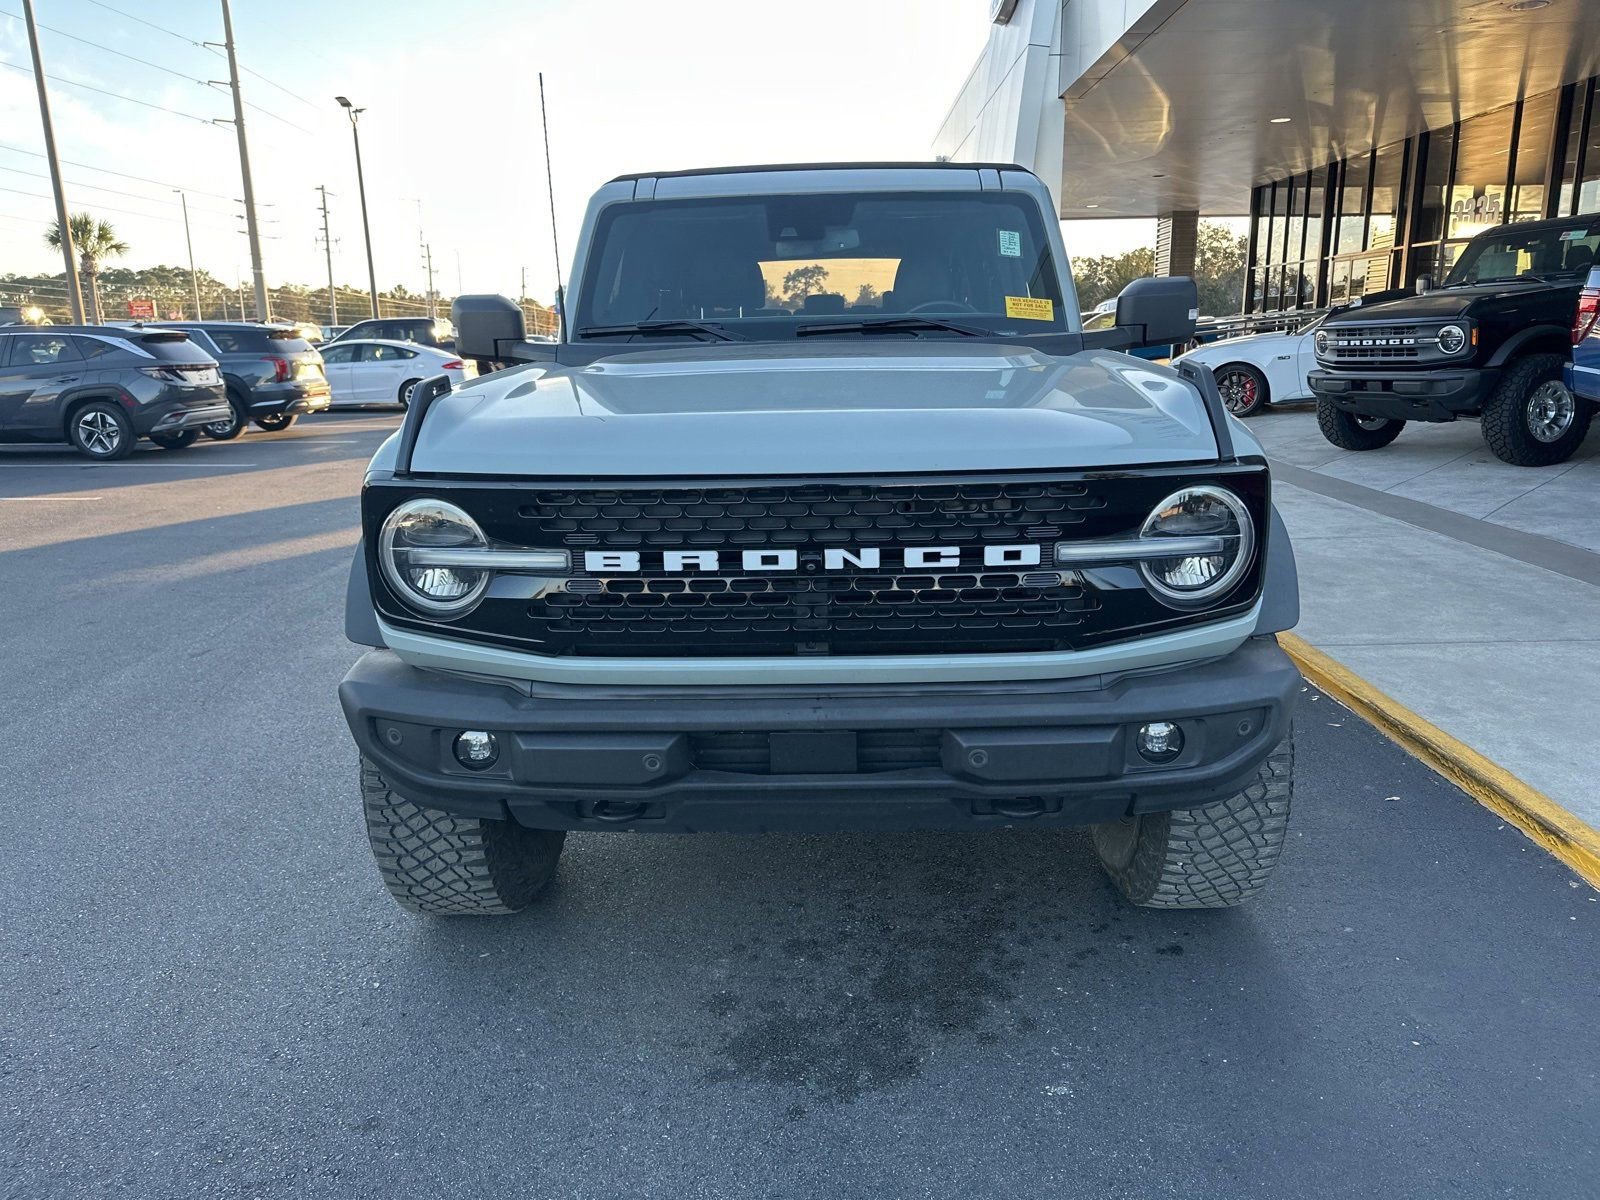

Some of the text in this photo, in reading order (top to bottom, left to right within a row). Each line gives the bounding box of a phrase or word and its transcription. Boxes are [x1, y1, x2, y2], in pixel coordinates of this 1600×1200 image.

[1452, 193, 1501, 228] 3335
[1338, 338, 1415, 346] BRONCO
[584, 544, 1041, 572] BRONCO
